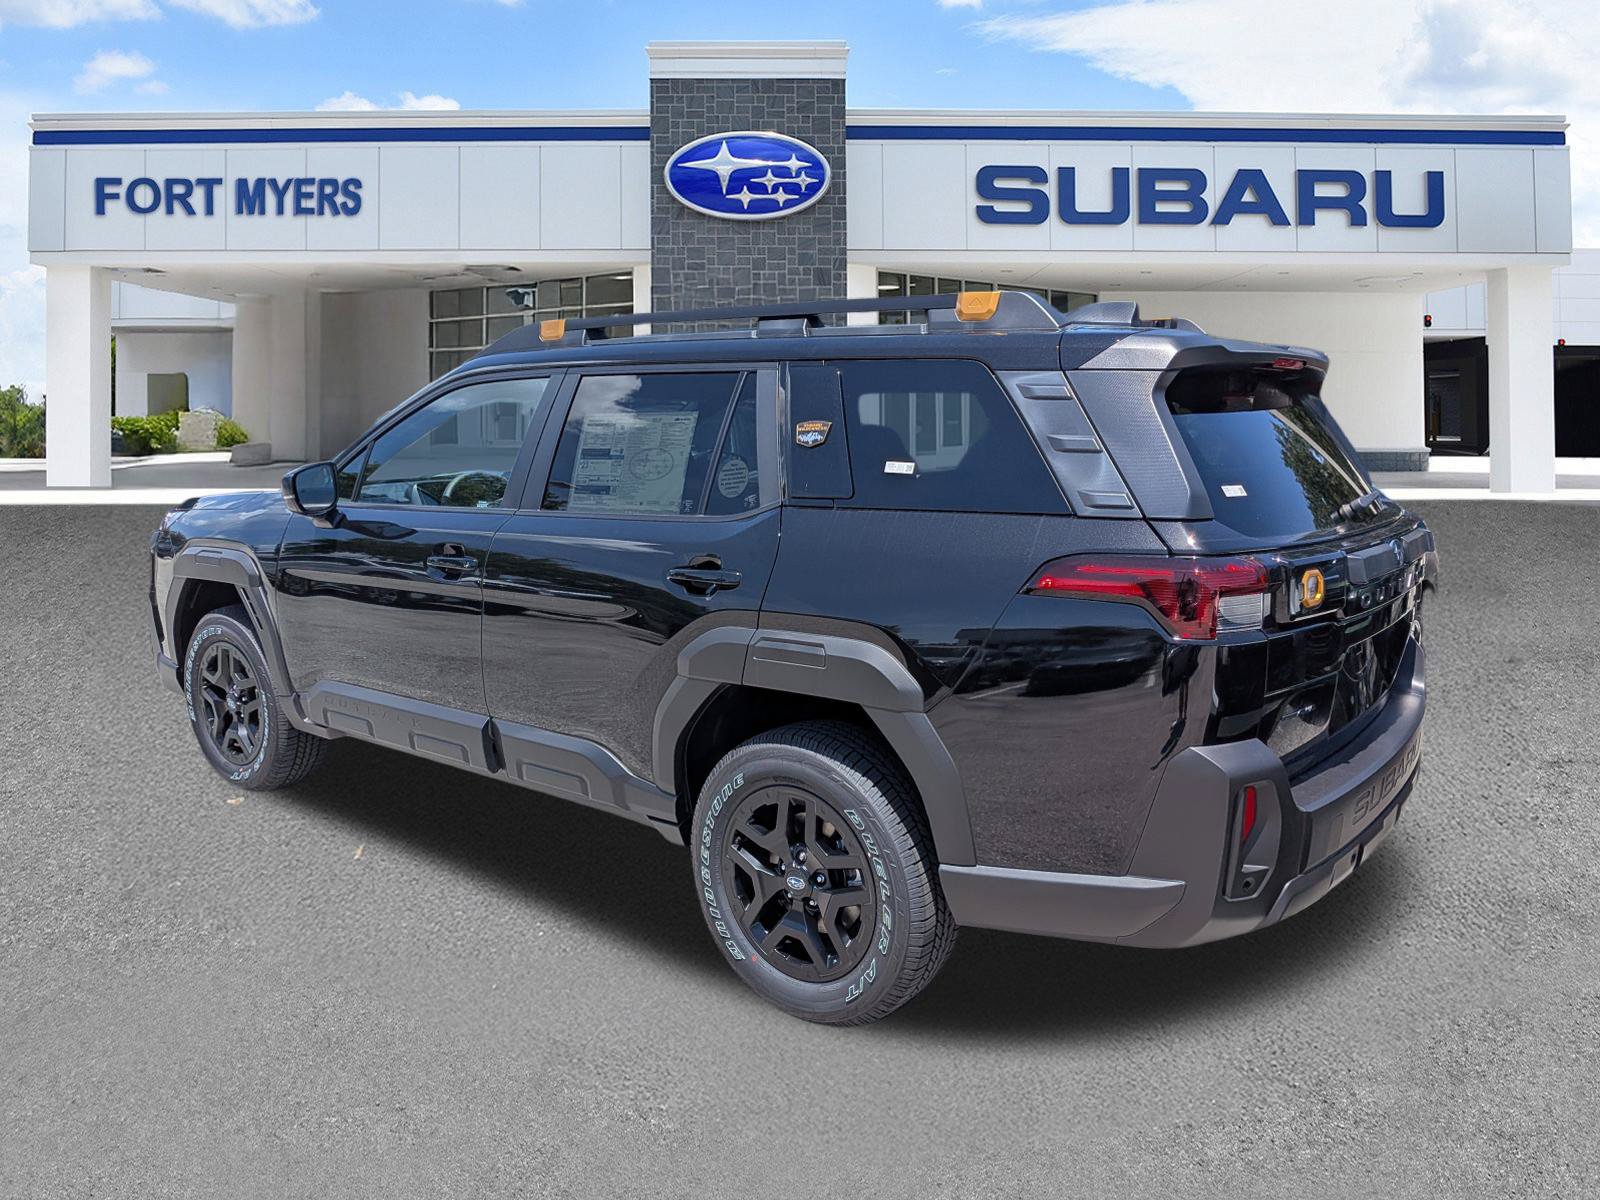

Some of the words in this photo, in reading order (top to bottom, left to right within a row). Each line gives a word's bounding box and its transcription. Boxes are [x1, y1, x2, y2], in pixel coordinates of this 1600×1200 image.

[95, 177, 223, 216] FORT
[236, 177, 363, 217] MYERS
[975, 165, 1445, 229] SUBARU
[1352, 732, 1422, 826] SUBARU
[700, 772, 746, 961] BRIDGESTONE
[844, 808, 893, 956] DUELER
[845, 957, 878, 1003] A/T
